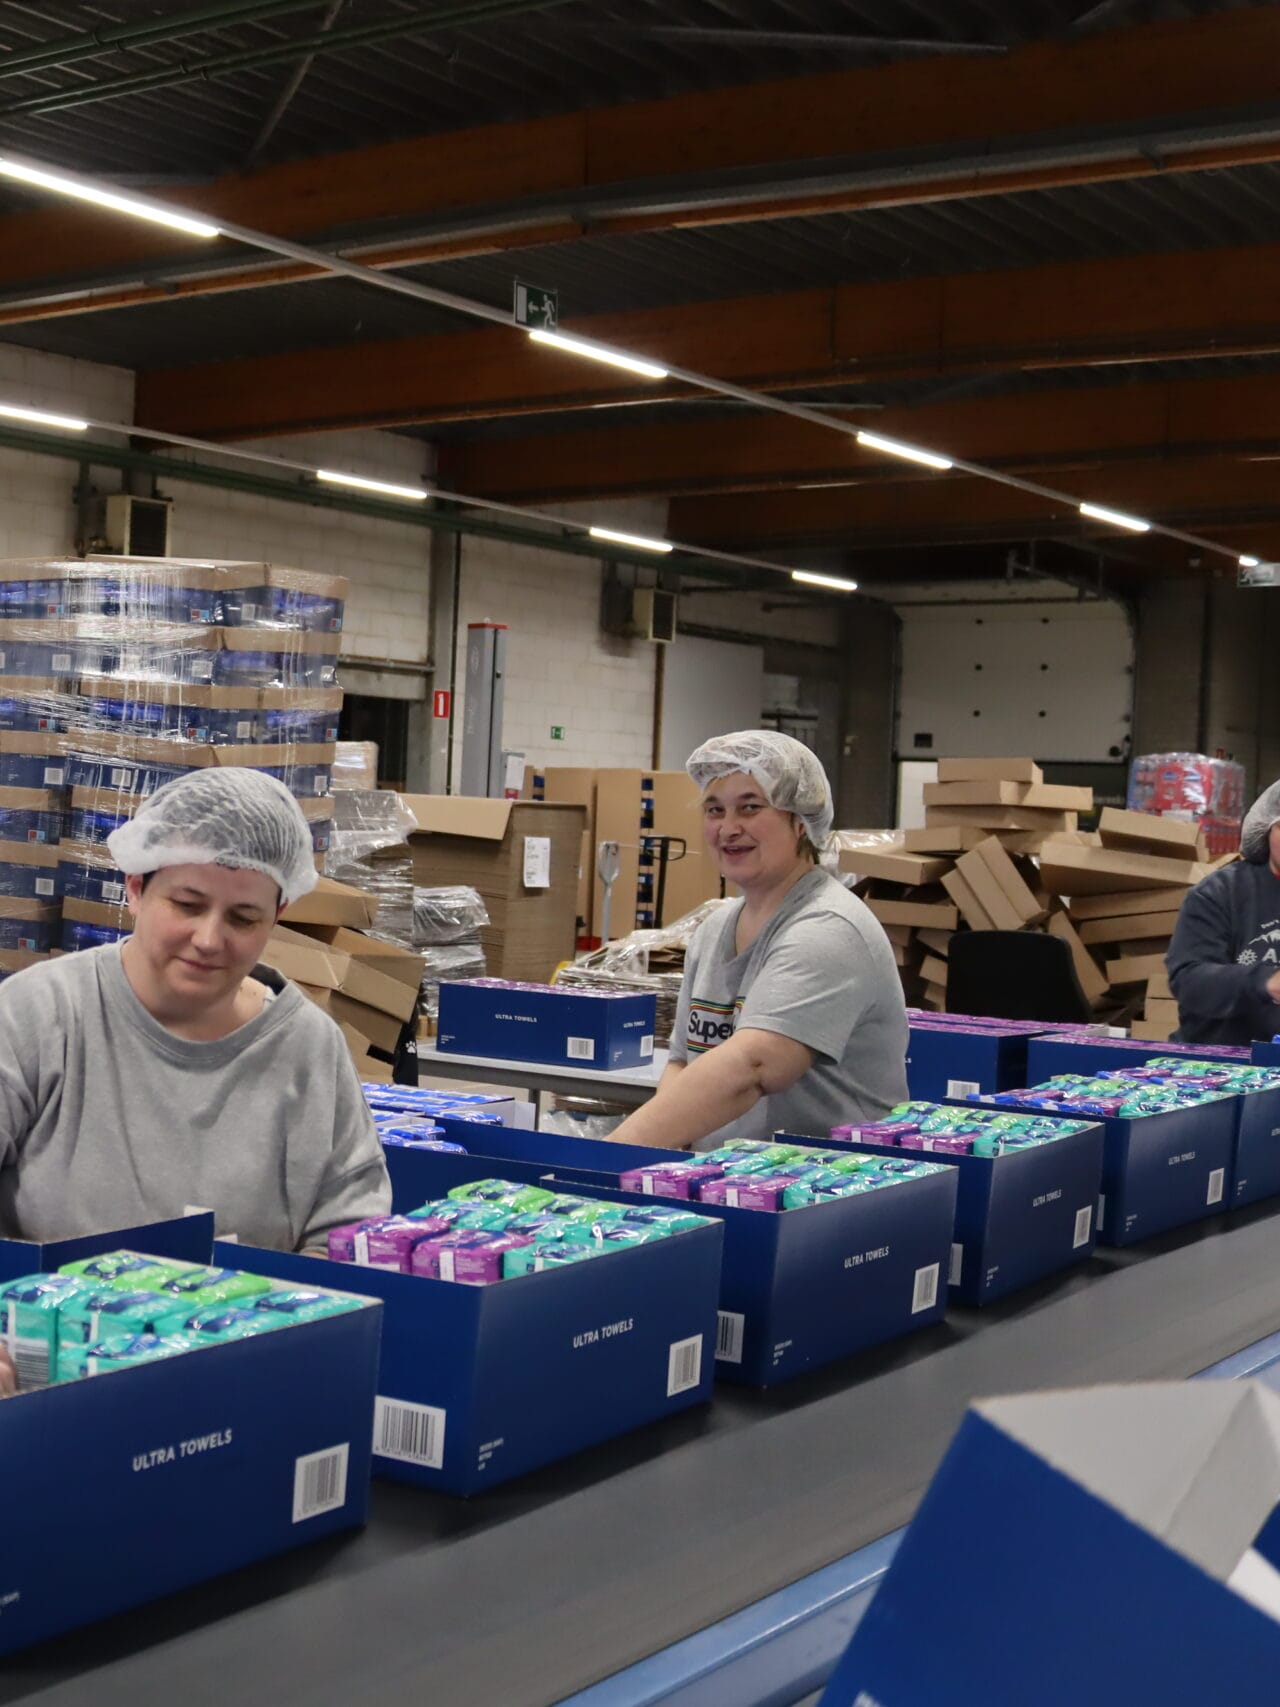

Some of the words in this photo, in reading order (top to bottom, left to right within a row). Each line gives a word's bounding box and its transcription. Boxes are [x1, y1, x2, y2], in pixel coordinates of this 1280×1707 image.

[494, 1013, 512, 1022] ULTRA
[514, 1014, 537, 1023] TOWELS
[688, 1011, 736, 1043] Supe
[1032, 1194, 1046, 1208] ULTRA
[1046, 1189, 1062, 1202] TOWELS
[844, 1255, 864, 1269] ULTRA
[866, 1246, 890, 1262] TOWELS
[573, 1329, 600, 1348] ULTRA
[601, 1318, 634, 1339] TOWELS
[132, 1446, 175, 1472] ULTRA
[179, 1429, 232, 1458] TOWELS
